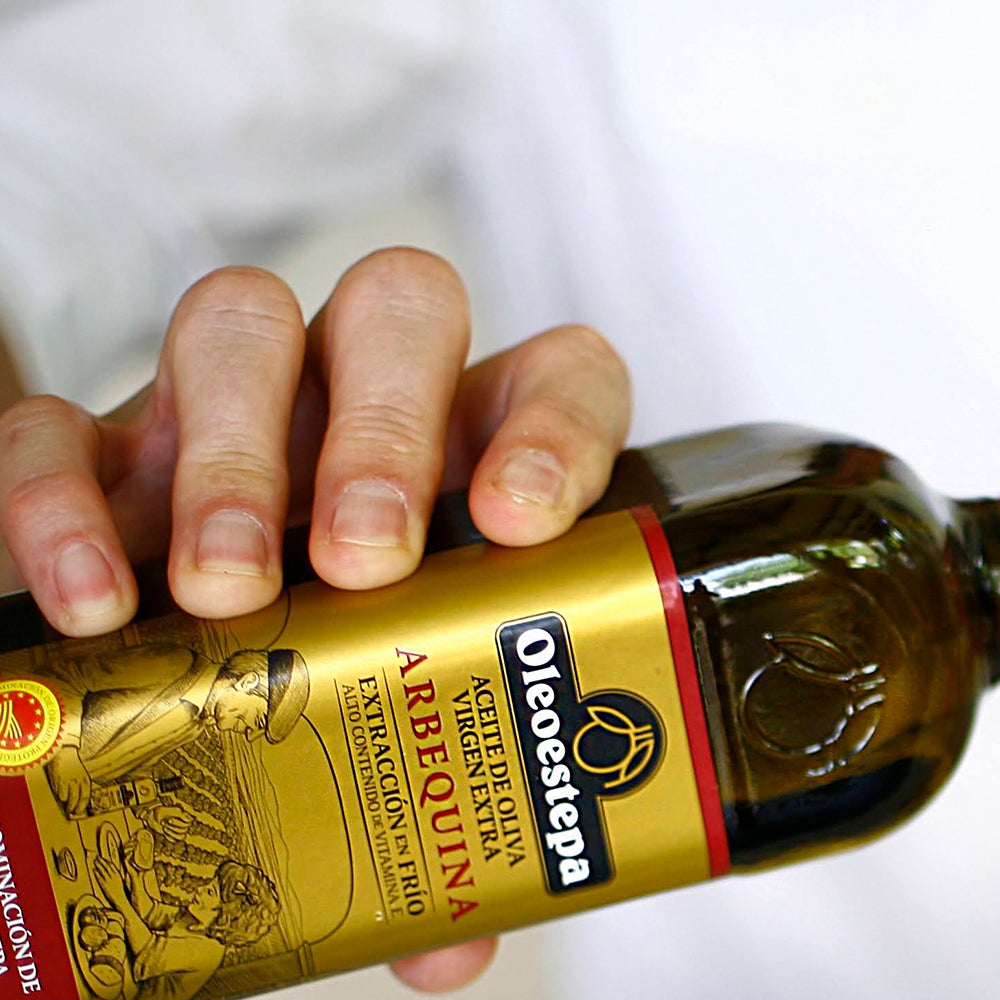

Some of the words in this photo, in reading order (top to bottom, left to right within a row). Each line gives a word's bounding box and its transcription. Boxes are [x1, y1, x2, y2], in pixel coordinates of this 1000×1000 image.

[342, 684, 361, 722] ALTO
[471, 675, 505, 758] ACEITE
[352, 725, 381, 812] CONTENIDO
[358, 675, 408, 830] EXTRACCIÓN
[395, 647, 479, 922] ARBEQUINA
[452, 688, 486, 778] VIRGEN
[471, 783, 501, 862] EXTRA
[489, 760, 512, 794] DE
[516, 628, 590, 885] Oleoestepa
[371, 814, 384, 829] DE
[395, 834, 410, 856] EN
[497, 797, 526, 868] OLIVA
[375, 830, 401, 905] VITAMINA
[398, 860, 428, 916] FRÍO
[391, 906, 404, 919] E
[17, 961, 42, 995] DE
